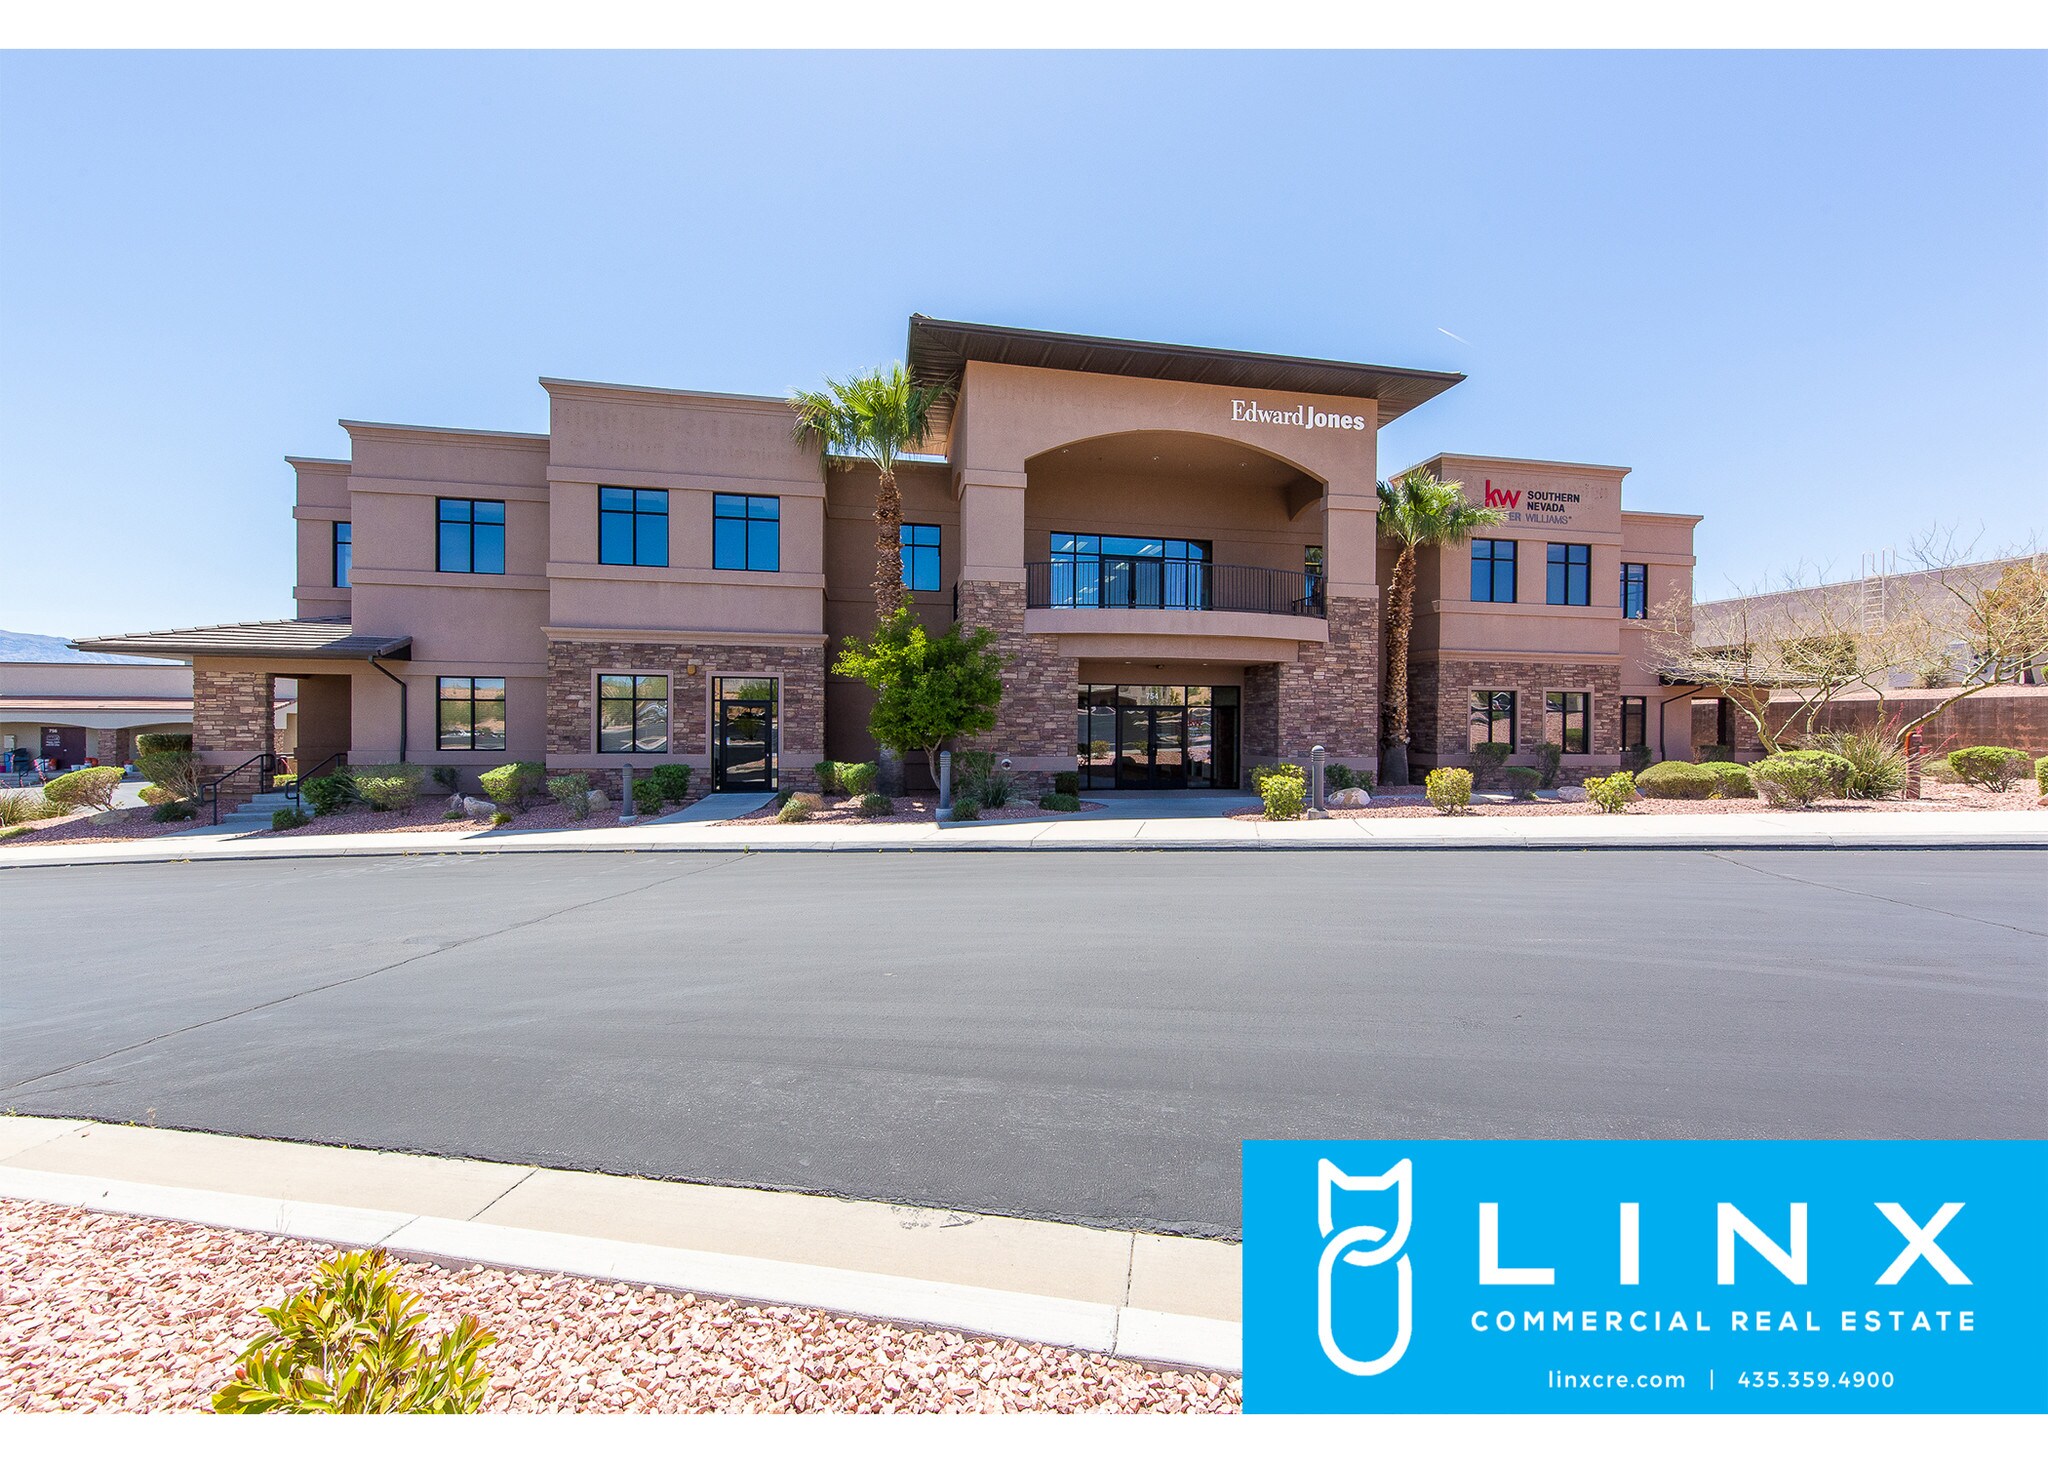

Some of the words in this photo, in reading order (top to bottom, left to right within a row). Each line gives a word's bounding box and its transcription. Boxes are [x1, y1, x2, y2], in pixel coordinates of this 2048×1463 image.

[1231, 399, 1304, 426] Edward
[1305, 406, 1365, 430] Jones
[1485, 479, 1522, 509] kw
[1527, 491, 1580, 503] SOUTHERN
[1526, 502, 1565, 512] NEVADA
